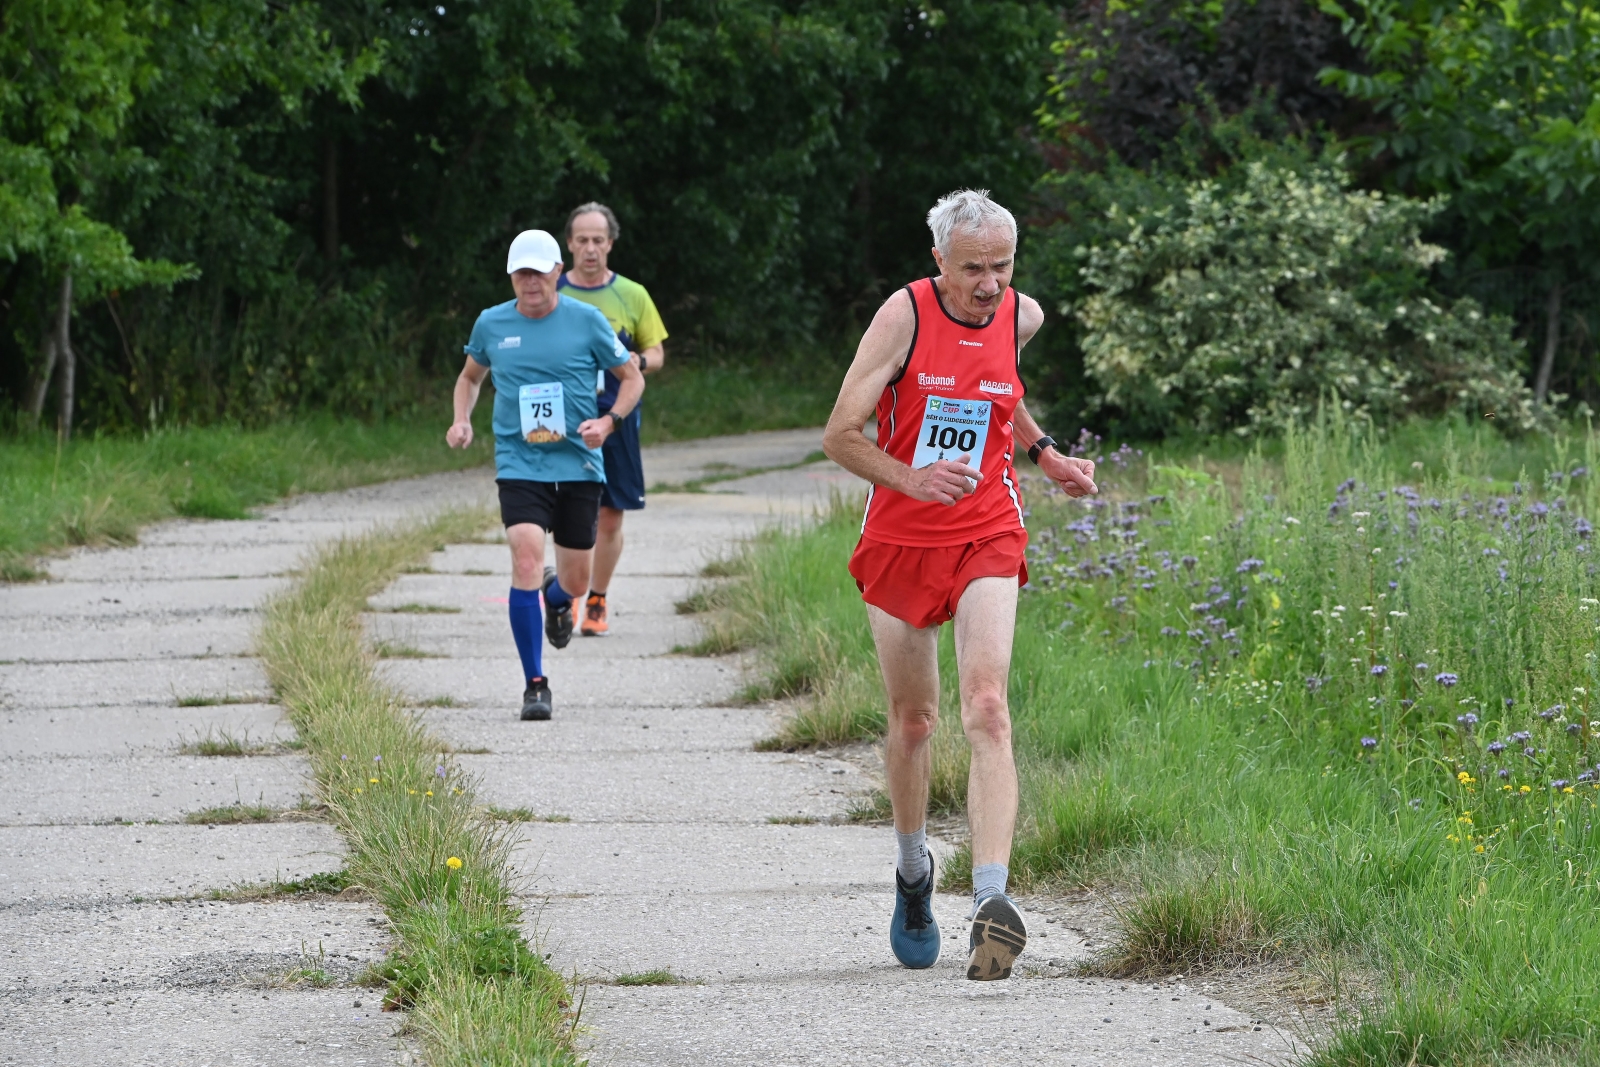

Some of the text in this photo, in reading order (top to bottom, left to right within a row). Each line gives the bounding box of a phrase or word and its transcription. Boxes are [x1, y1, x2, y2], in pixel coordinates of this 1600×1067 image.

[979, 379, 1013, 390] MARATON
[531, 401, 553, 419] 75
[926, 424, 977, 452] 100
